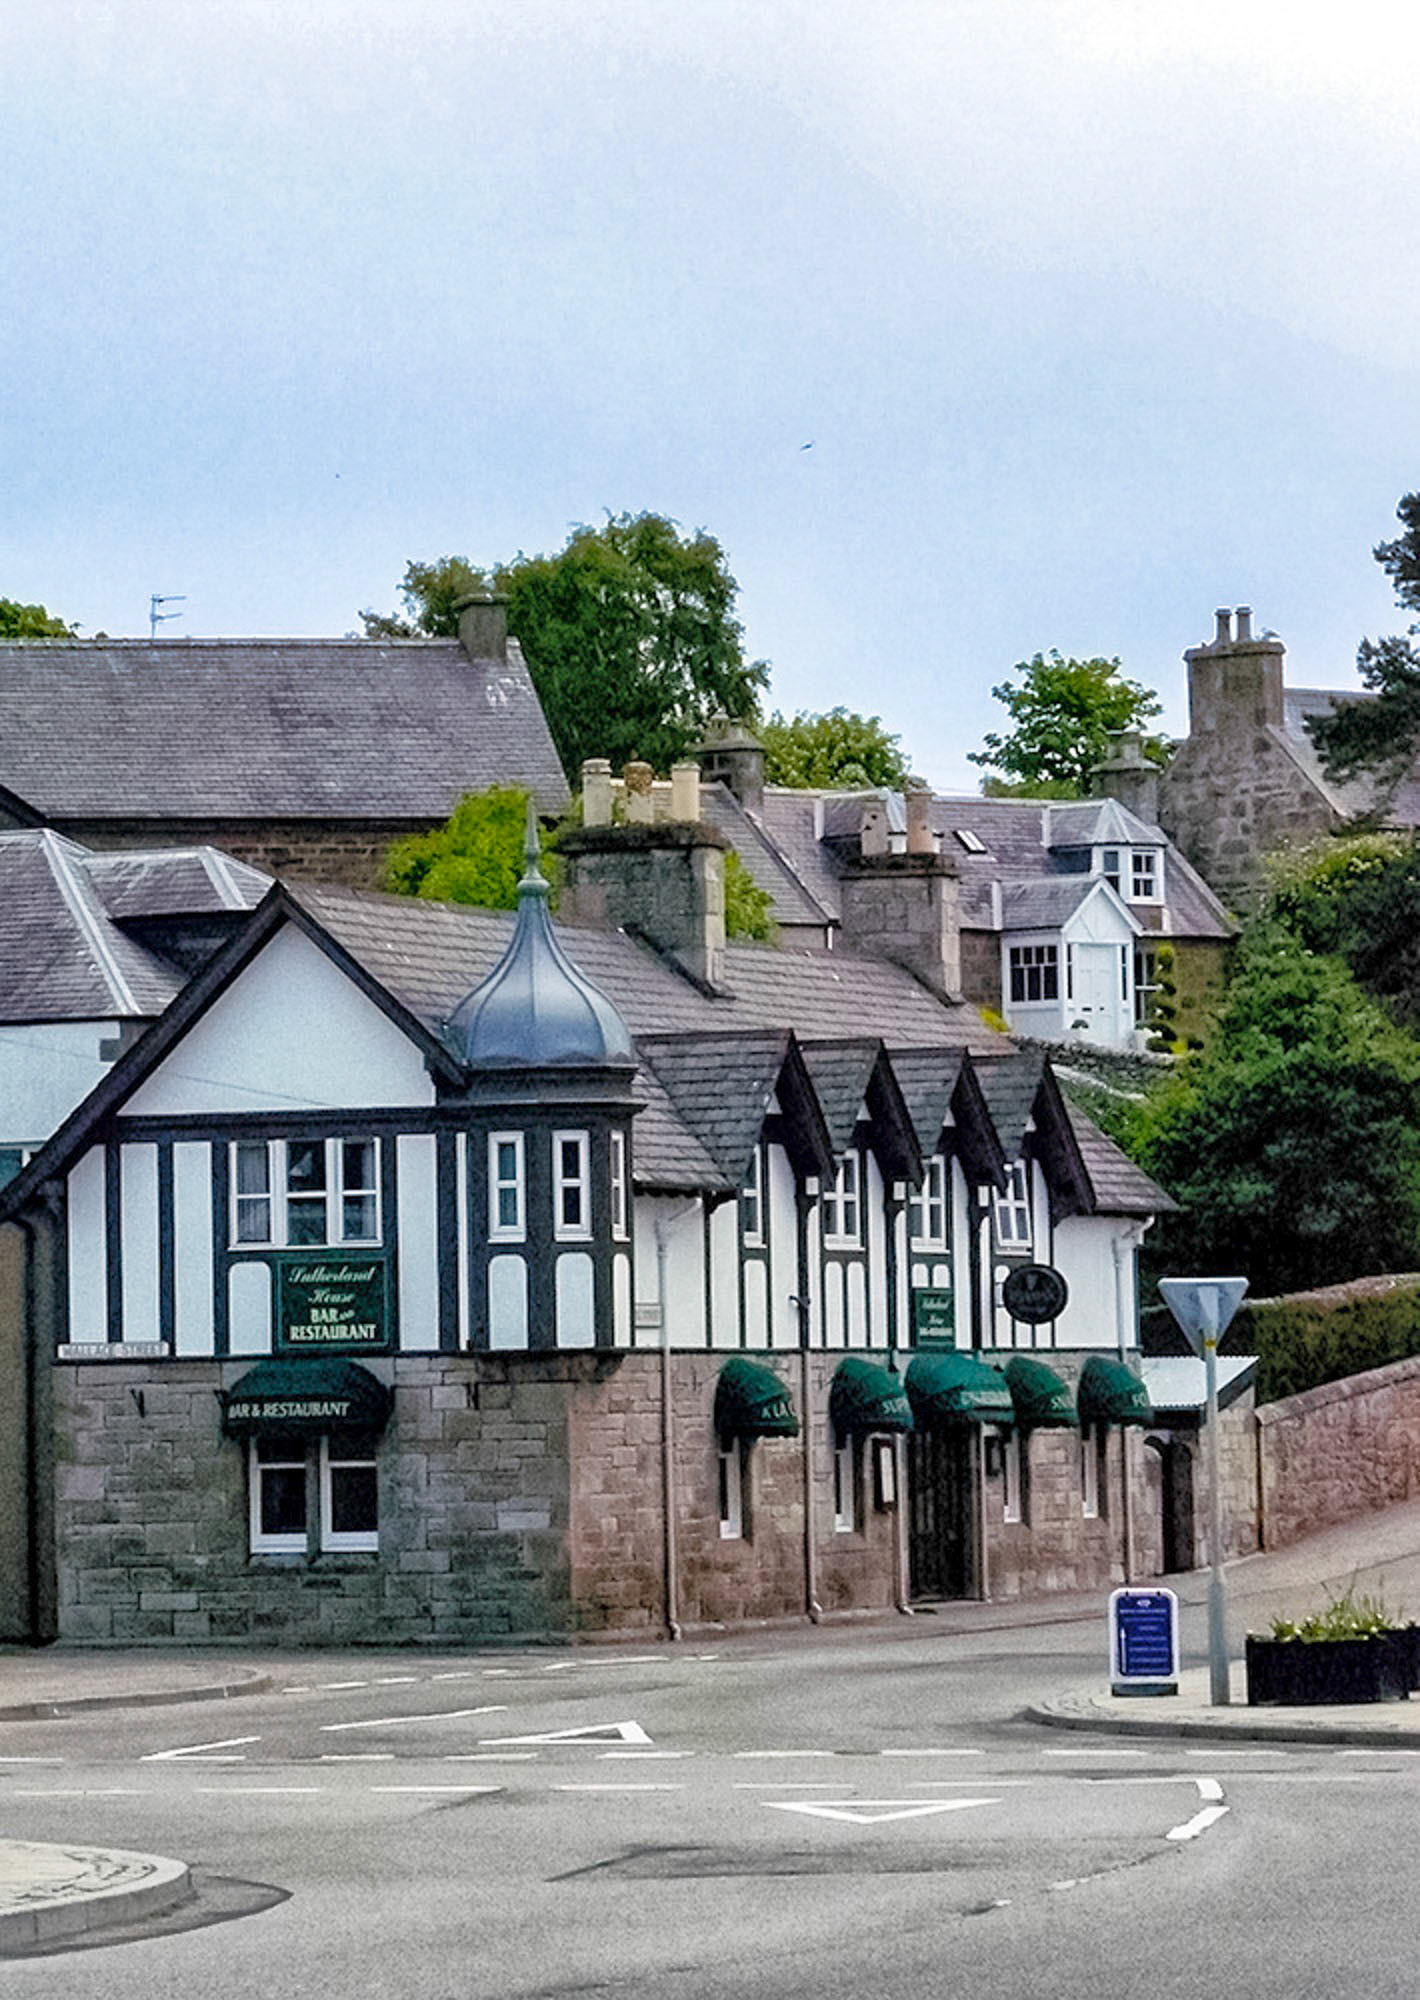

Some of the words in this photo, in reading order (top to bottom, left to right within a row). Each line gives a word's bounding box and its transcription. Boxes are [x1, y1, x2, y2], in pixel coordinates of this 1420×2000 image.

[288, 1265, 377, 1283] Sutherland
[308, 1287, 355, 1304] House
[310, 1307, 339, 1323] BAR
[289, 1323, 377, 1341] RESTAURANT
[251, 1403, 260, 1417] &
[263, 1401, 351, 1417] RESTAURANT
